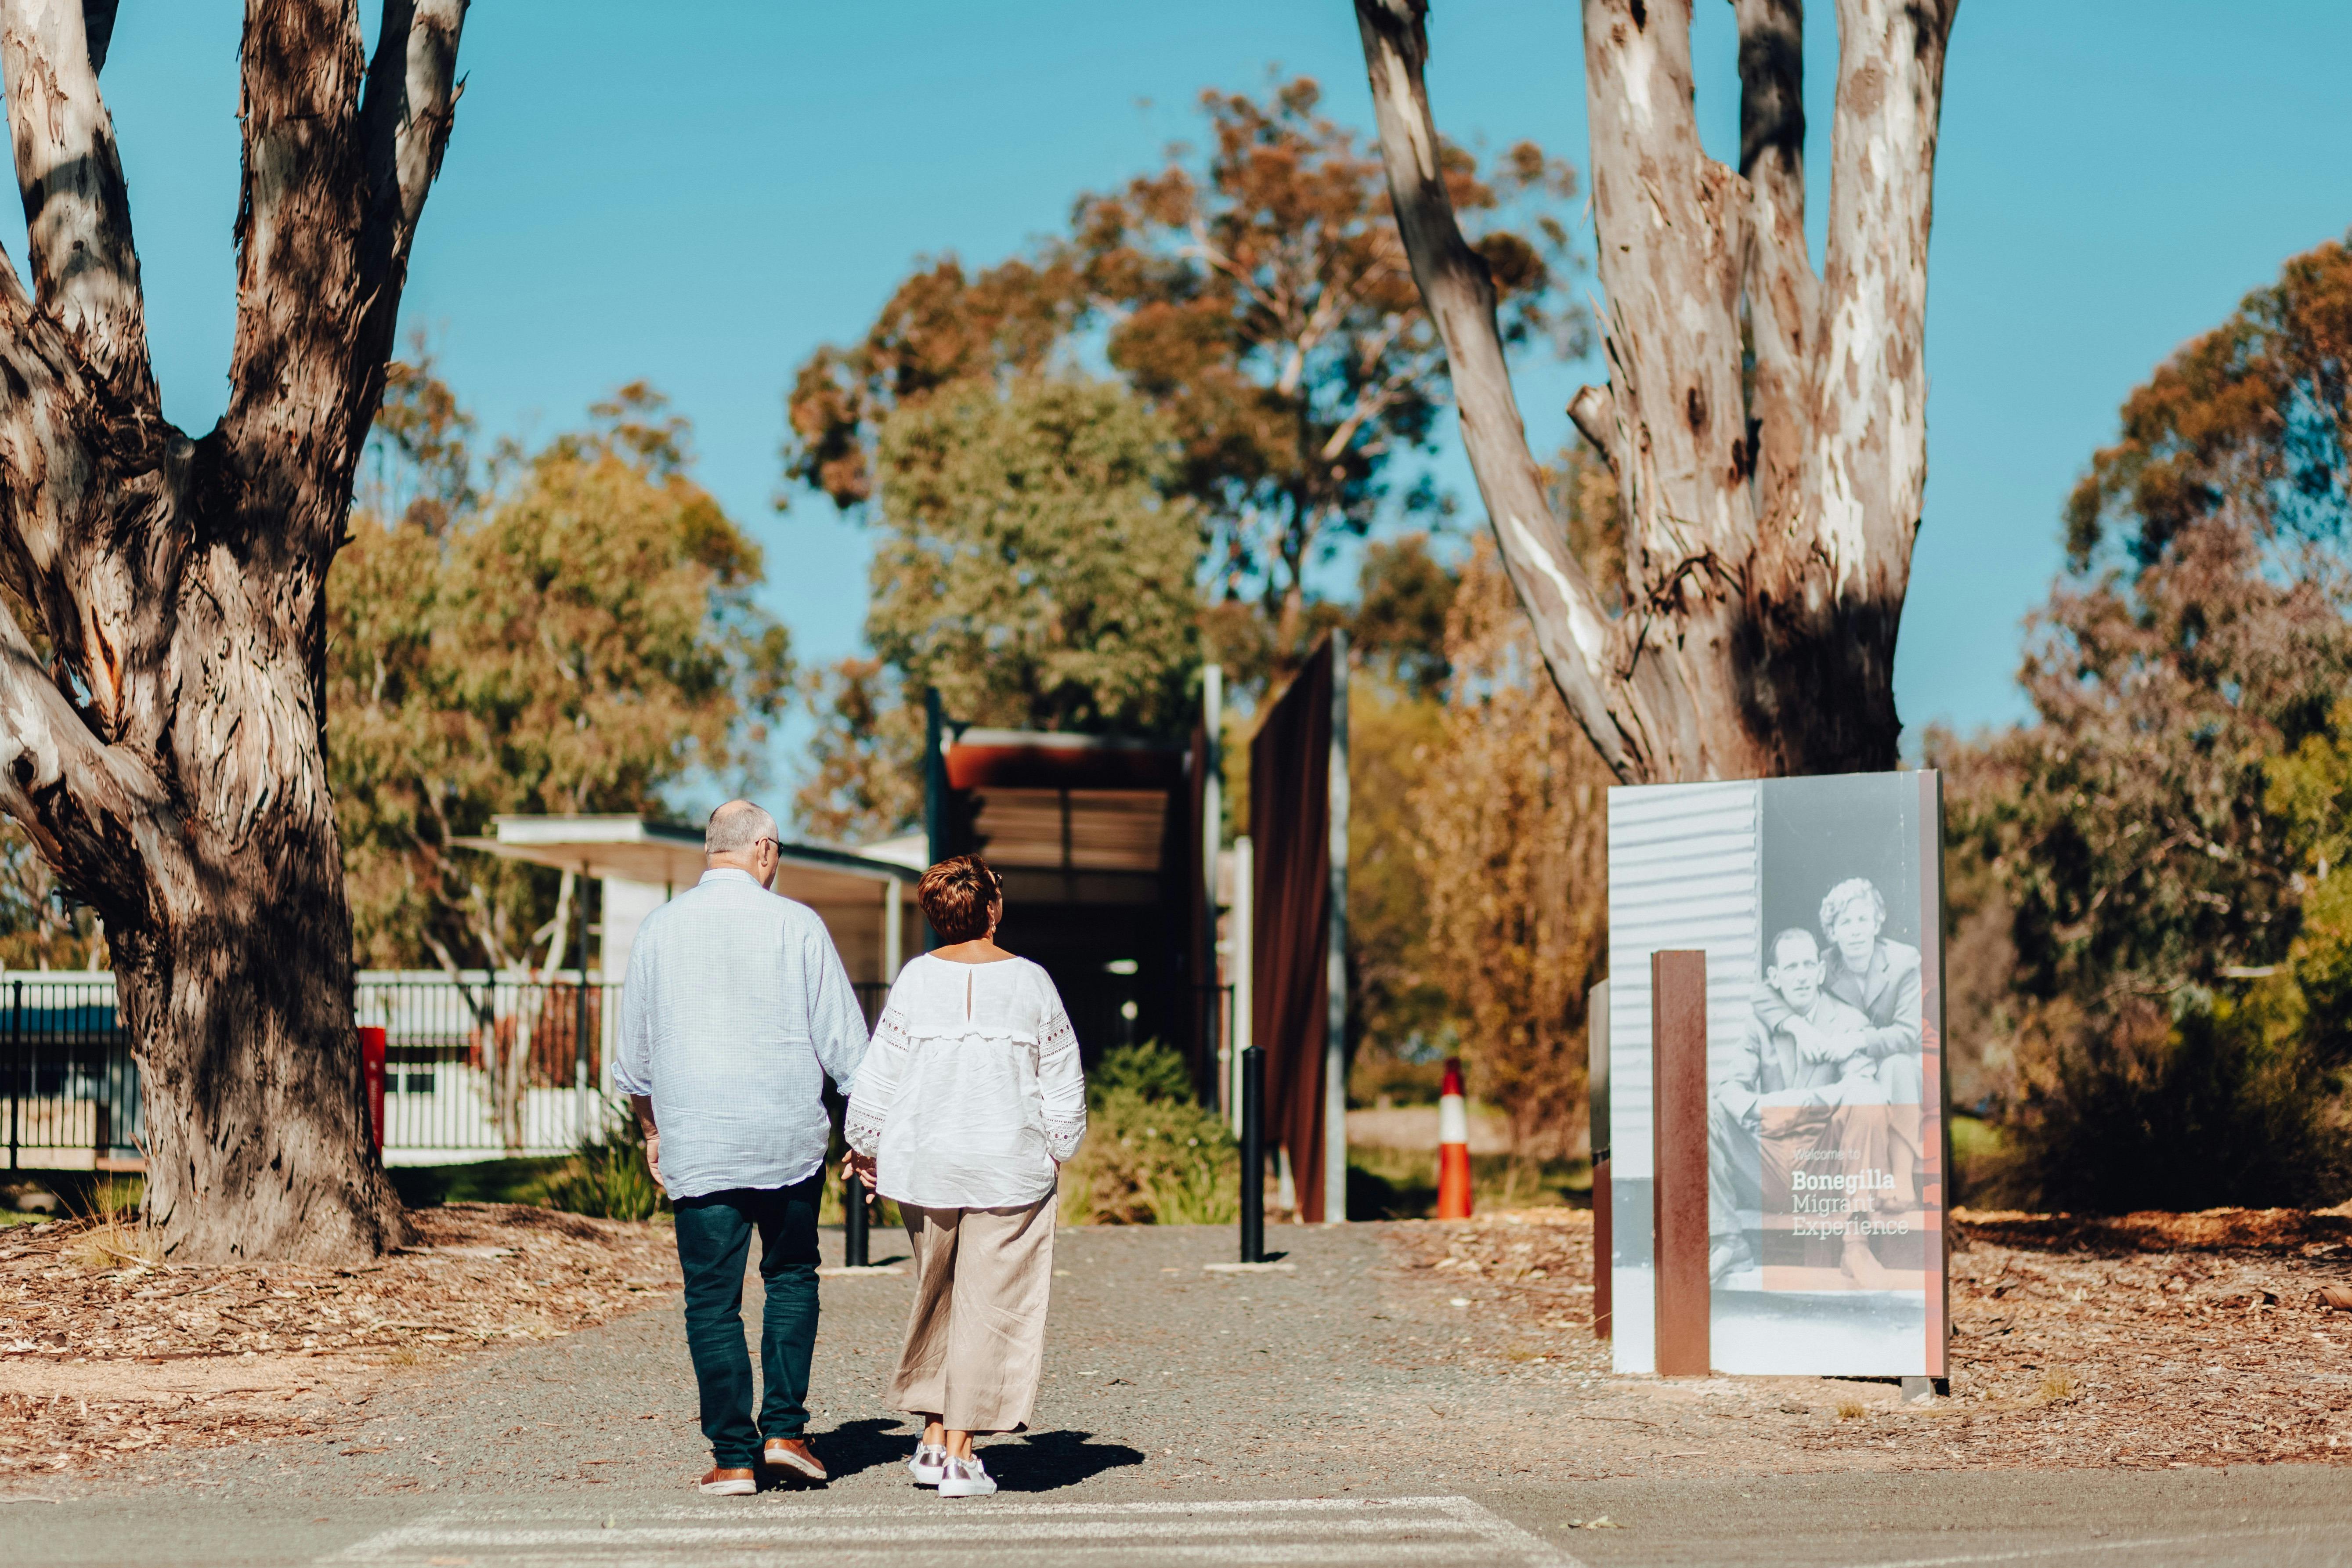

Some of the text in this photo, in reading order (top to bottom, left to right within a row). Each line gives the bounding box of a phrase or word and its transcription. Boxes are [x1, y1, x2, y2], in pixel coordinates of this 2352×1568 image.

[1793, 1148, 1861, 1160] Welcome to
[1791, 1169, 1895, 1195] Bonegilla
[1792, 1194, 1875, 1217] Migrant
[1792, 1216, 1909, 1240] Experience
